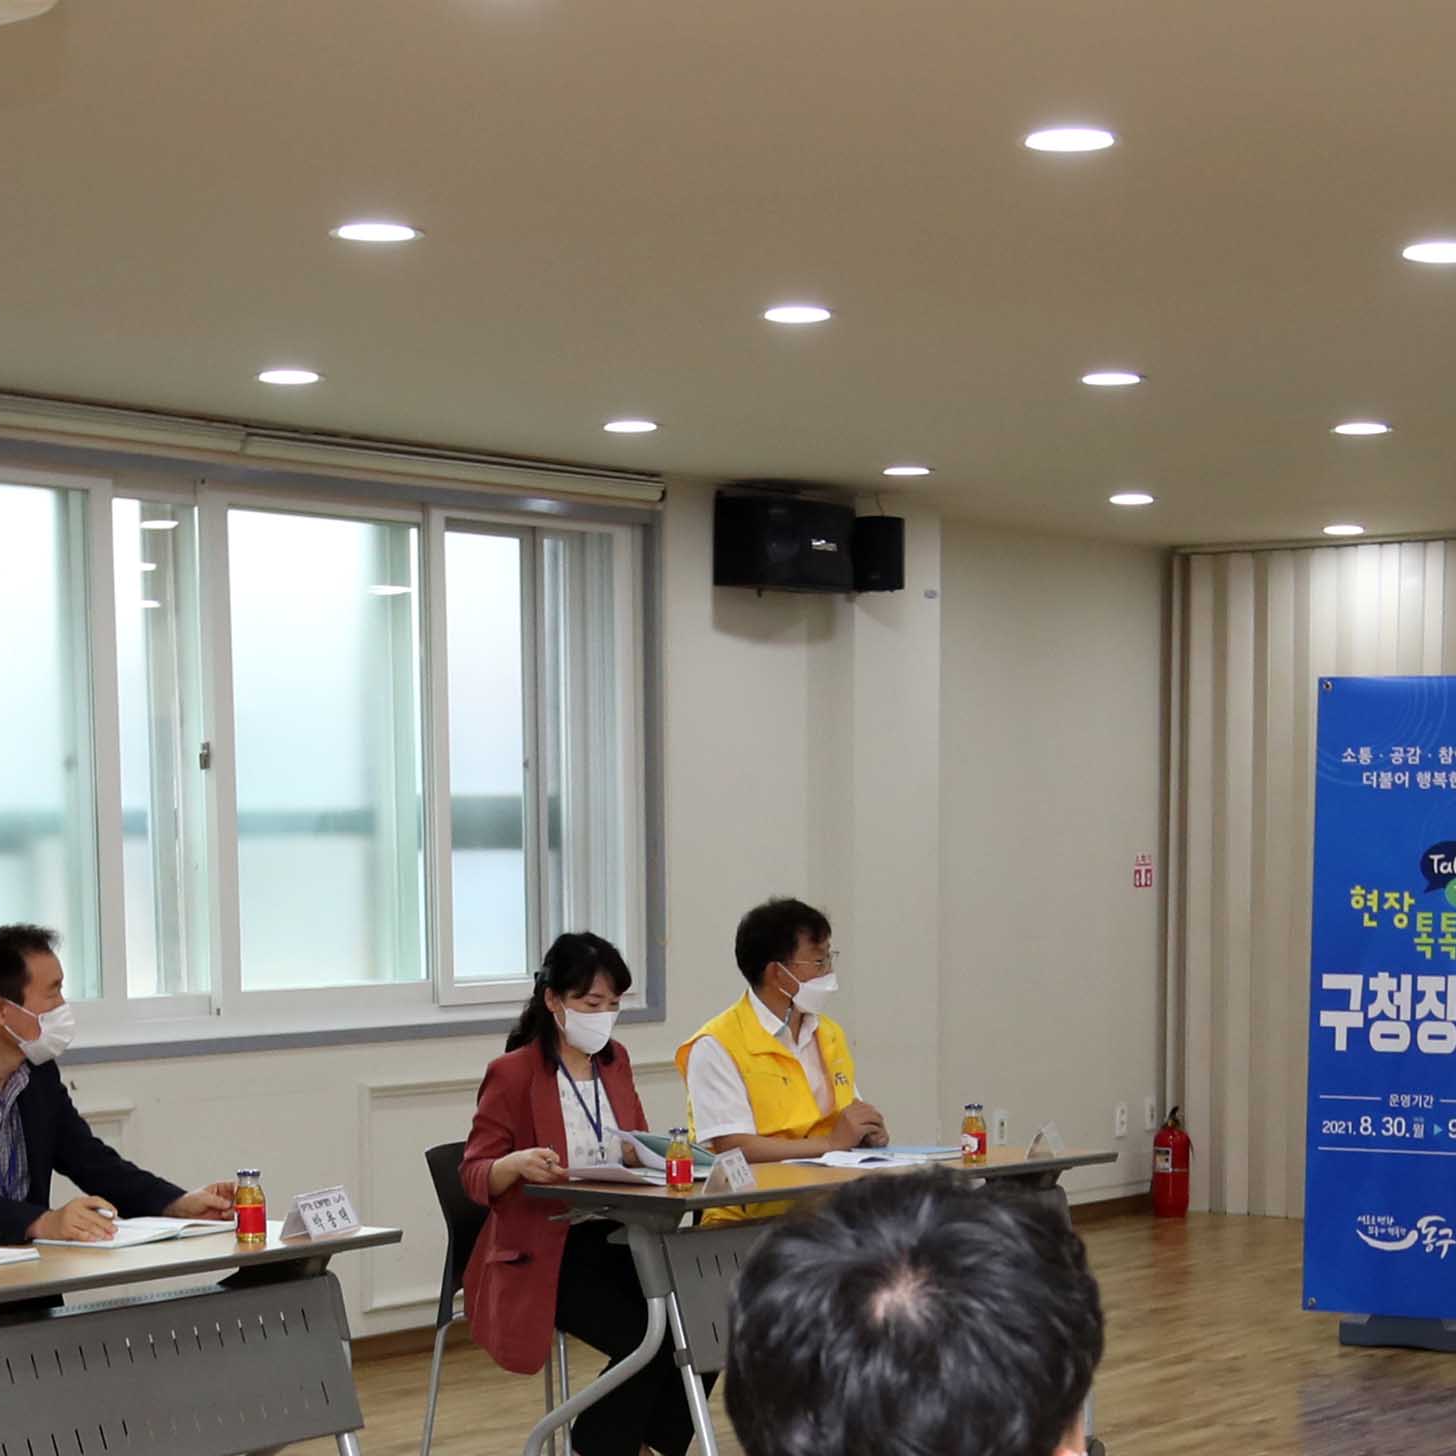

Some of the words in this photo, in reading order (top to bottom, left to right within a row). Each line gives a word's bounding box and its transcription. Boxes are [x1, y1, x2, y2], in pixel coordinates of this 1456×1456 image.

[1342, 746, 1373, 765] 소통
[1390, 746, 1421, 765] 공감
[1362, 771, 1410, 789] 더불어
[1350, 885, 1415, 928] 현장
[1389, 1093, 1434, 1109] 운영기간
